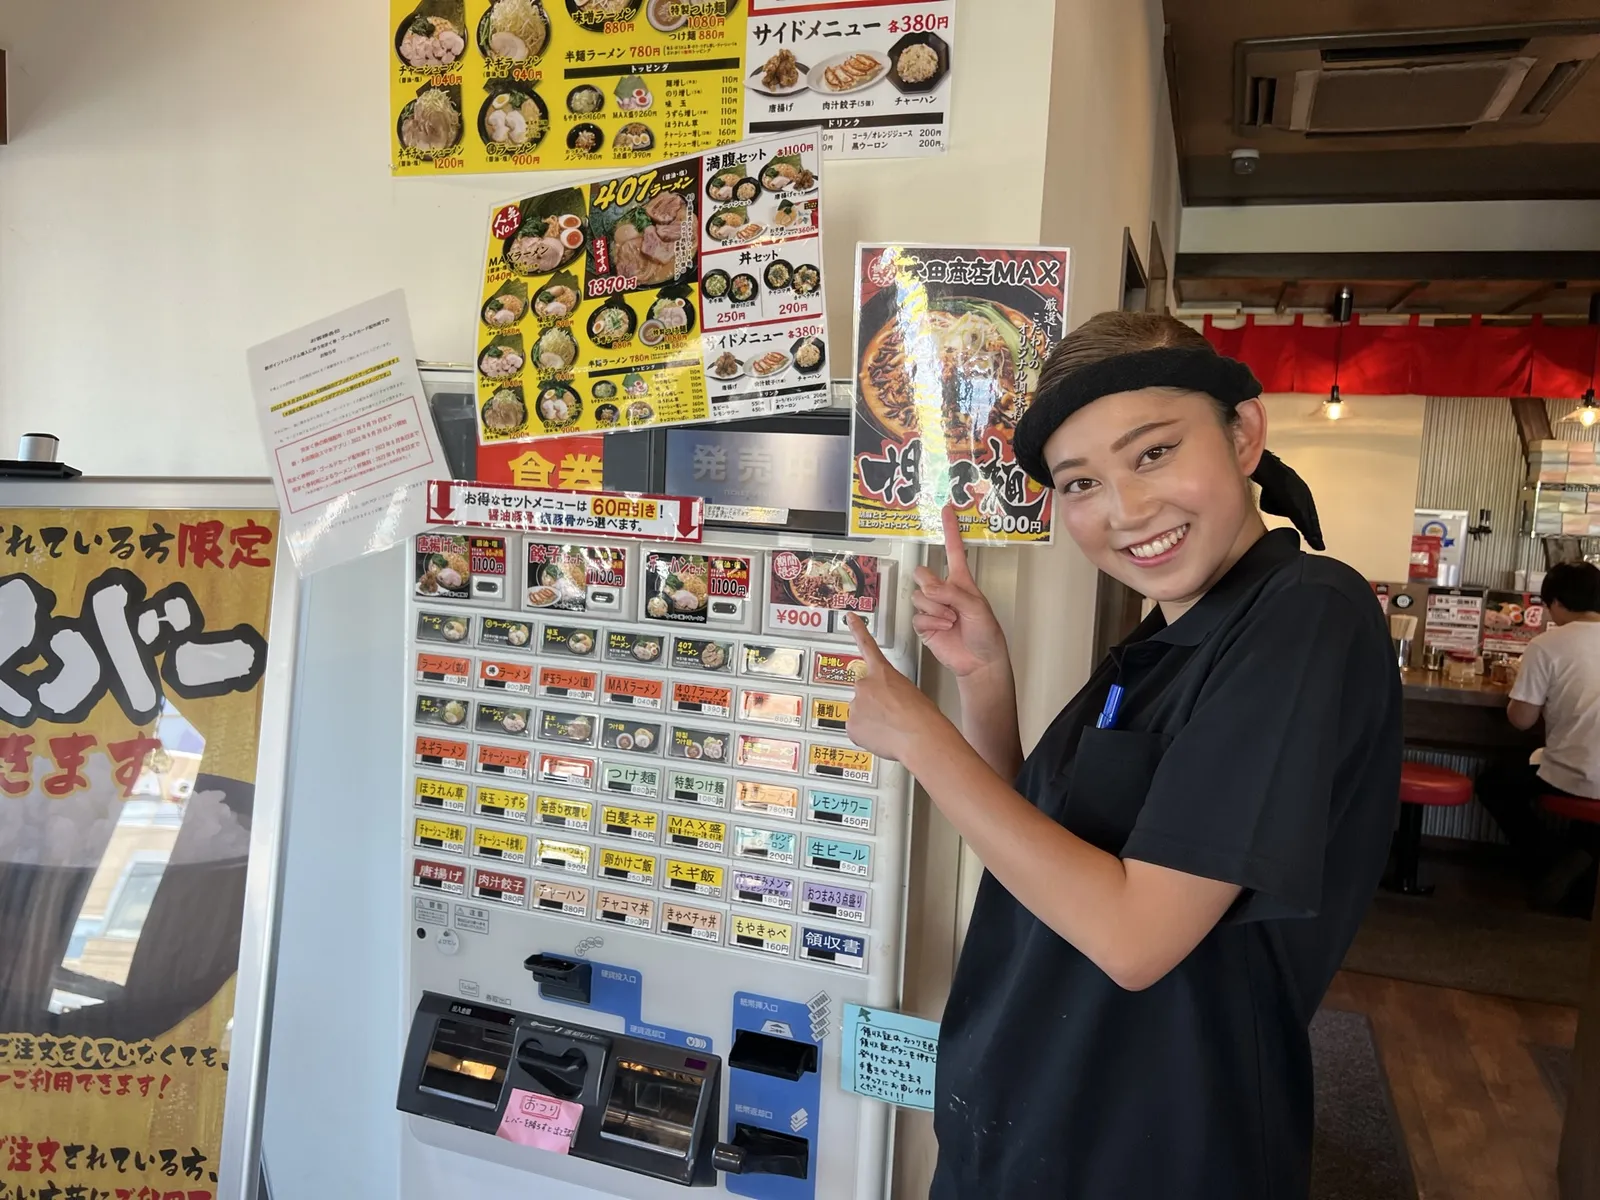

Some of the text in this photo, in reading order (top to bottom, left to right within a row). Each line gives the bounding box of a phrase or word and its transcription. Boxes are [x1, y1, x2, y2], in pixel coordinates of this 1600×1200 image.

[573, 7, 637, 24] 味噌ラーメン
[670, 2, 726, 16] 特製つけ麺
[604, 22, 634, 34] 880円
[688, 16, 725, 28] 1080円
[669, 30, 724, 41] つけ麺 880円
[752, 14, 949, 46] サイドメニュー 各380円
[565, 48, 626, 62] 半麺ラーメン
[630, 46, 661, 57] 780円
[399, 62, 465, 76] チャーシューメン
[484, 57, 543, 69] ネギラーメン
[631, 63, 669, 73] トッピング
[431, 74, 462, 86] 1040円
[513, 69, 542, 80] 940円
[722, 76, 738, 84] 110円
[721, 87, 738, 95] 110円
[721, 97, 738, 105] 110円
[768, 102, 794, 113] 唐揚げ
[895, 95, 937, 106] チャーハン
[665, 118, 737, 128] ほうれん草 110円
[828, 118, 860, 128] ドリンク
[719, 128, 737, 136] 160円
[919, 129, 942, 138] 200円
[852, 139, 941, 151] 黒ウーロン 200円
[398, 146, 465, 159] ネギチャーシューメン
[706, 144, 813, 172] 満腹セット 各1100円
[434, 157, 464, 169] 1200円
[512, 155, 540, 166] 900円
[593, 169, 696, 211] 407 ラーメン
[494, 206, 520, 228] 人気
[495, 219, 520, 238] No.1
[488, 246, 550, 267] MAXラーメン
[595, 239, 608, 273] おすすめ
[739, 250, 779, 266] 丼セット
[487, 271, 512, 283] 1040円
[588, 276, 638, 296] 1390円
[779, 303, 808, 314] 290円
[716, 311, 746, 323] 250円
[1029, 311, 1043, 370] こだわりの
[630, 353, 650, 363] 780円
[507, 450, 603, 490] 食券
[464, 492, 587, 513] お得なセットメニューは
[989, 515, 1042, 533] 900円
[417, 535, 468, 554] 唐揚げセット
[472, 557, 504, 573] 1100円
[589, 569, 623, 586] 1100円
[710, 578, 746, 596] 1100円
[832, 593, 873, 611] 担々麺
[775, 609, 822, 628] ¥900
[609, 640, 631, 649] ラーメン
[610, 633, 626, 642] MAX
[677, 641, 693, 650] 407
[677, 648, 699, 657] ラーメン
[607, 678, 659, 696] MAXラーメン
[676, 684, 729, 699] 407ラーメン
[420, 741, 465, 758] ネギラーメン
[813, 747, 869, 764] お子様ラーメン
[480, 748, 528, 766] チャーシューメン
[608, 768, 657, 785] つけ麺
[844, 770, 869, 781] 360円
[419, 782, 465, 798] ほうれん草
[674, 775, 725, 794] 特製つけ麺
[444, 800, 464, 810] 110円
[812, 795, 869, 814] レモンサワー
[506, 810, 527, 820] 110円
[605, 810, 655, 828] 白髪ネギ
[843, 816, 869, 828] 450円
[566, 819, 588, 830] 110円
[420, 823, 464, 842] チャーシュー2枚増し
[633, 830, 655, 840] 160円
[443, 842, 464, 851] 160円
[478, 832, 523, 851] チャーシュー4枚増し
[698, 840, 722, 850] 260円
[503, 851, 524, 862] 260円
[769, 851, 793, 862] 200円
[811, 841, 866, 861] 生ビール
[604, 852, 653, 873] 卵かけご飯
[418, 864, 463, 882] 唐揚げ
[670, 864, 716, 883] ネギ飯
[442, 882, 464, 893] 380円
[478, 874, 524, 892] 肉汁餃子
[503, 893, 524, 904] 380円
[538, 883, 585, 903] チャーハン
[807, 887, 863, 907] おつまみ3点盛り
[563, 904, 585, 914] 380円
[601, 896, 649, 916] チャコマ丼
[837, 909, 862, 920] 390円
[765, 942, 789, 953] 160円
[805, 931, 861, 955] 領収書
[524, 1096, 559, 1117] おつり
